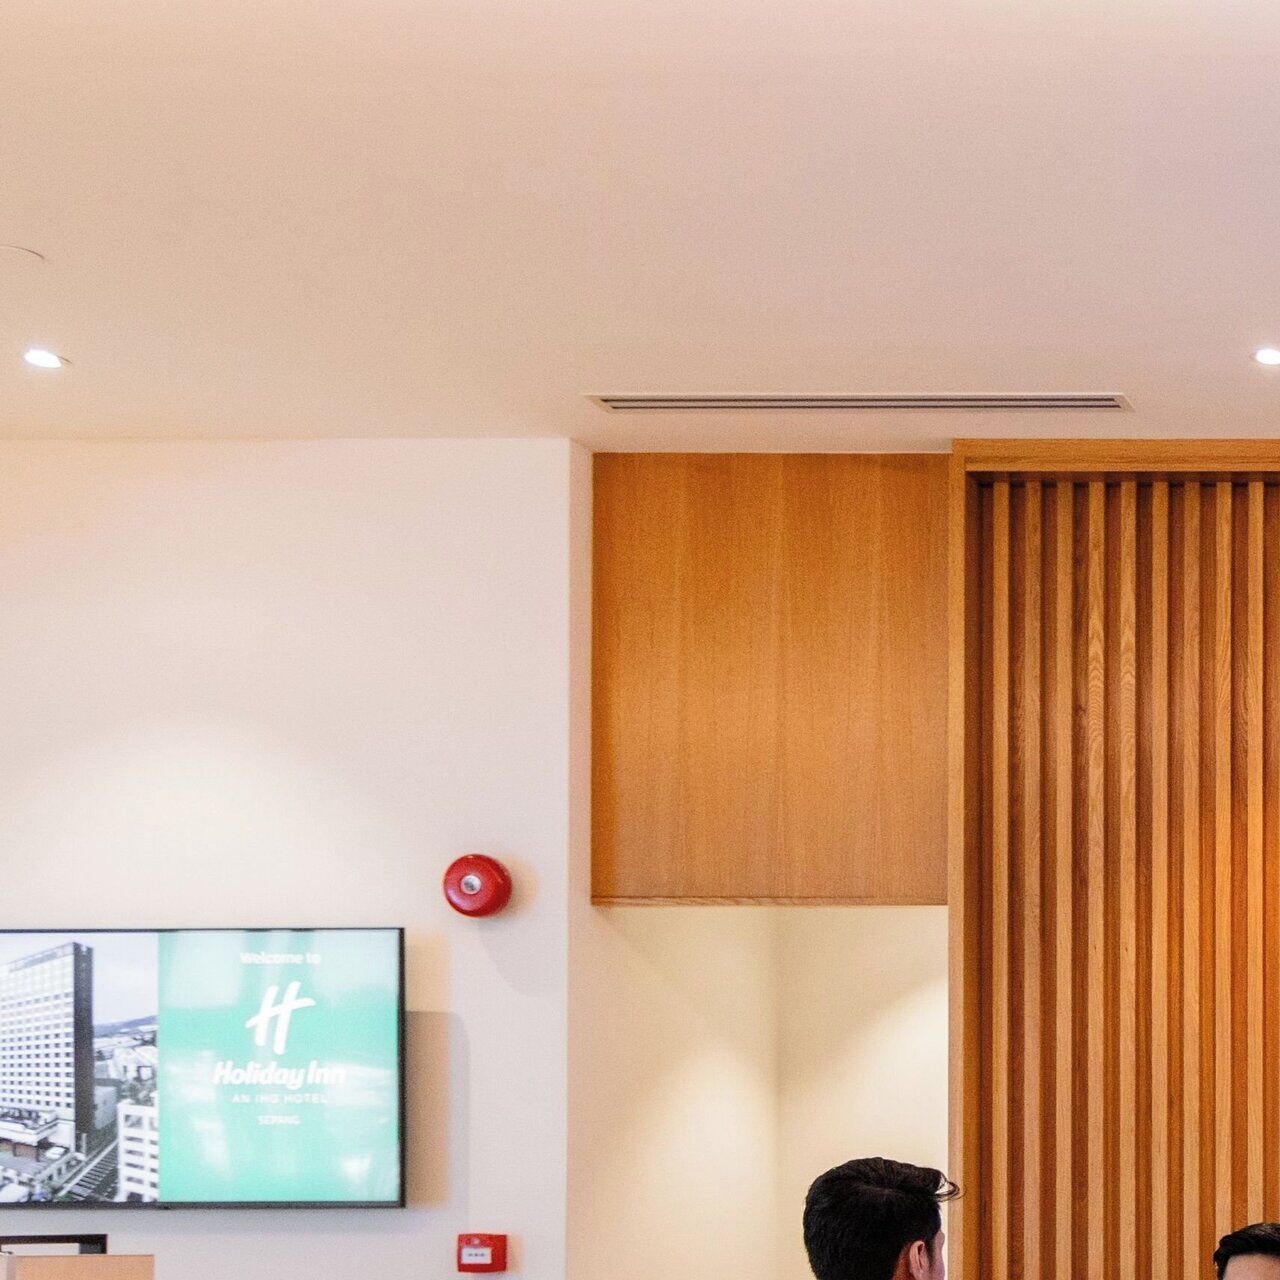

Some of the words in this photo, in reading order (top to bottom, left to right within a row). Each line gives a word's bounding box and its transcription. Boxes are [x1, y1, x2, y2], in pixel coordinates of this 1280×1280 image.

[239, 951, 303, 965] Welcome
[306, 952, 321, 965] to
[212, 1060, 305, 1091] Holiday
[307, 1060, 346, 1085] Inn
[232, 1093, 250, 1104] AN
[284, 1093, 327, 1104] HOTEL
